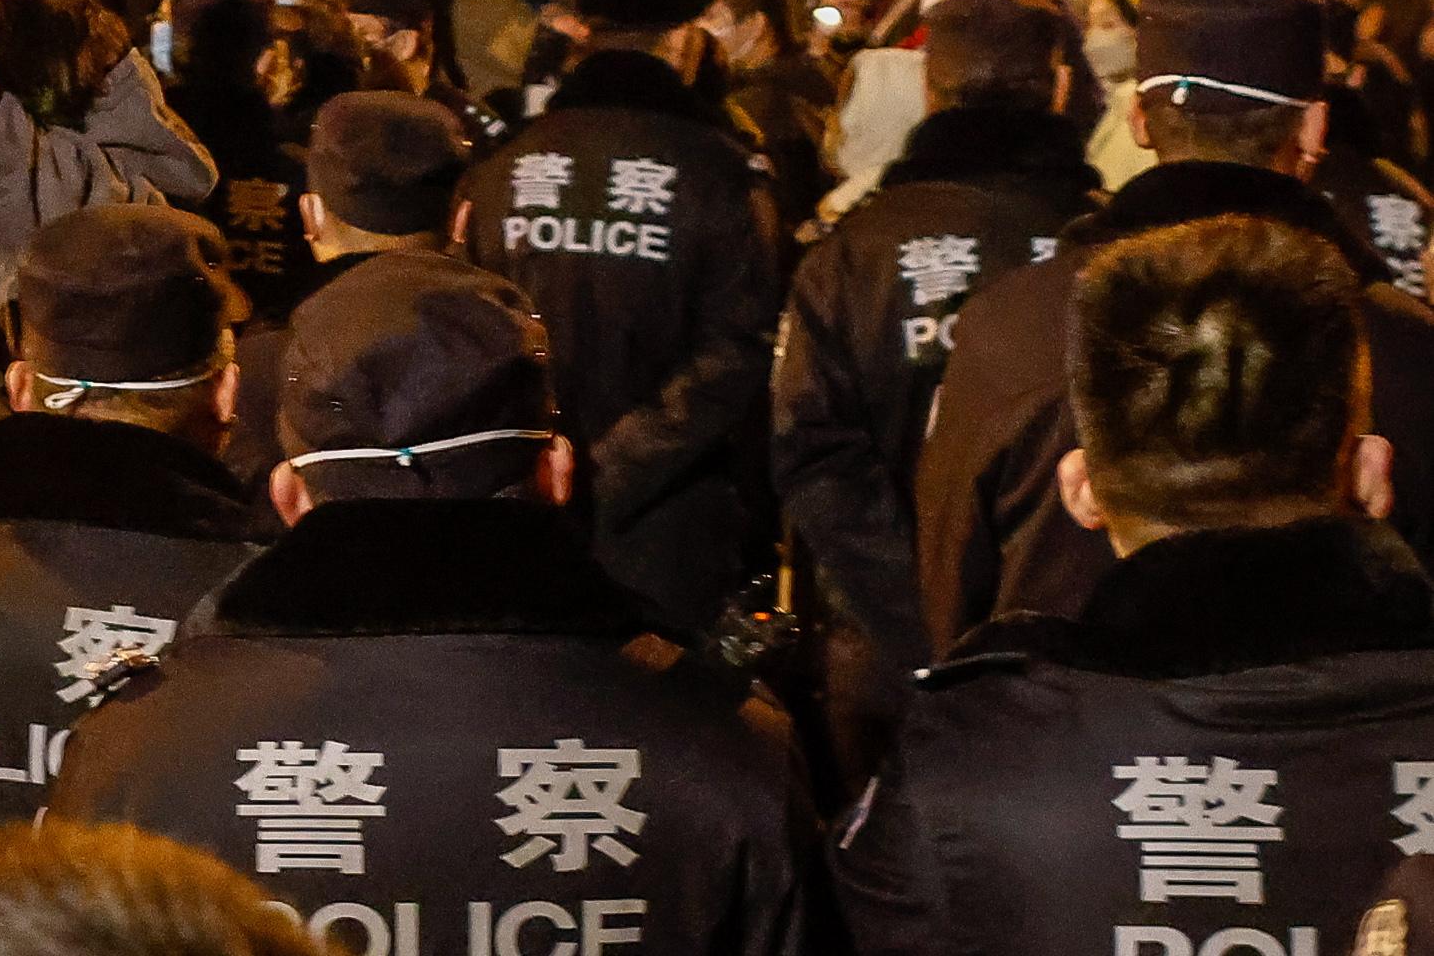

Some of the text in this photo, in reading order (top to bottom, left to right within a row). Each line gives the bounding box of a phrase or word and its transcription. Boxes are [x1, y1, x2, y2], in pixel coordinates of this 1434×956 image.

[511, 152, 677, 214] 警察
[503, 216, 669, 261] POLICE
[232, 738, 648, 875] 警察
